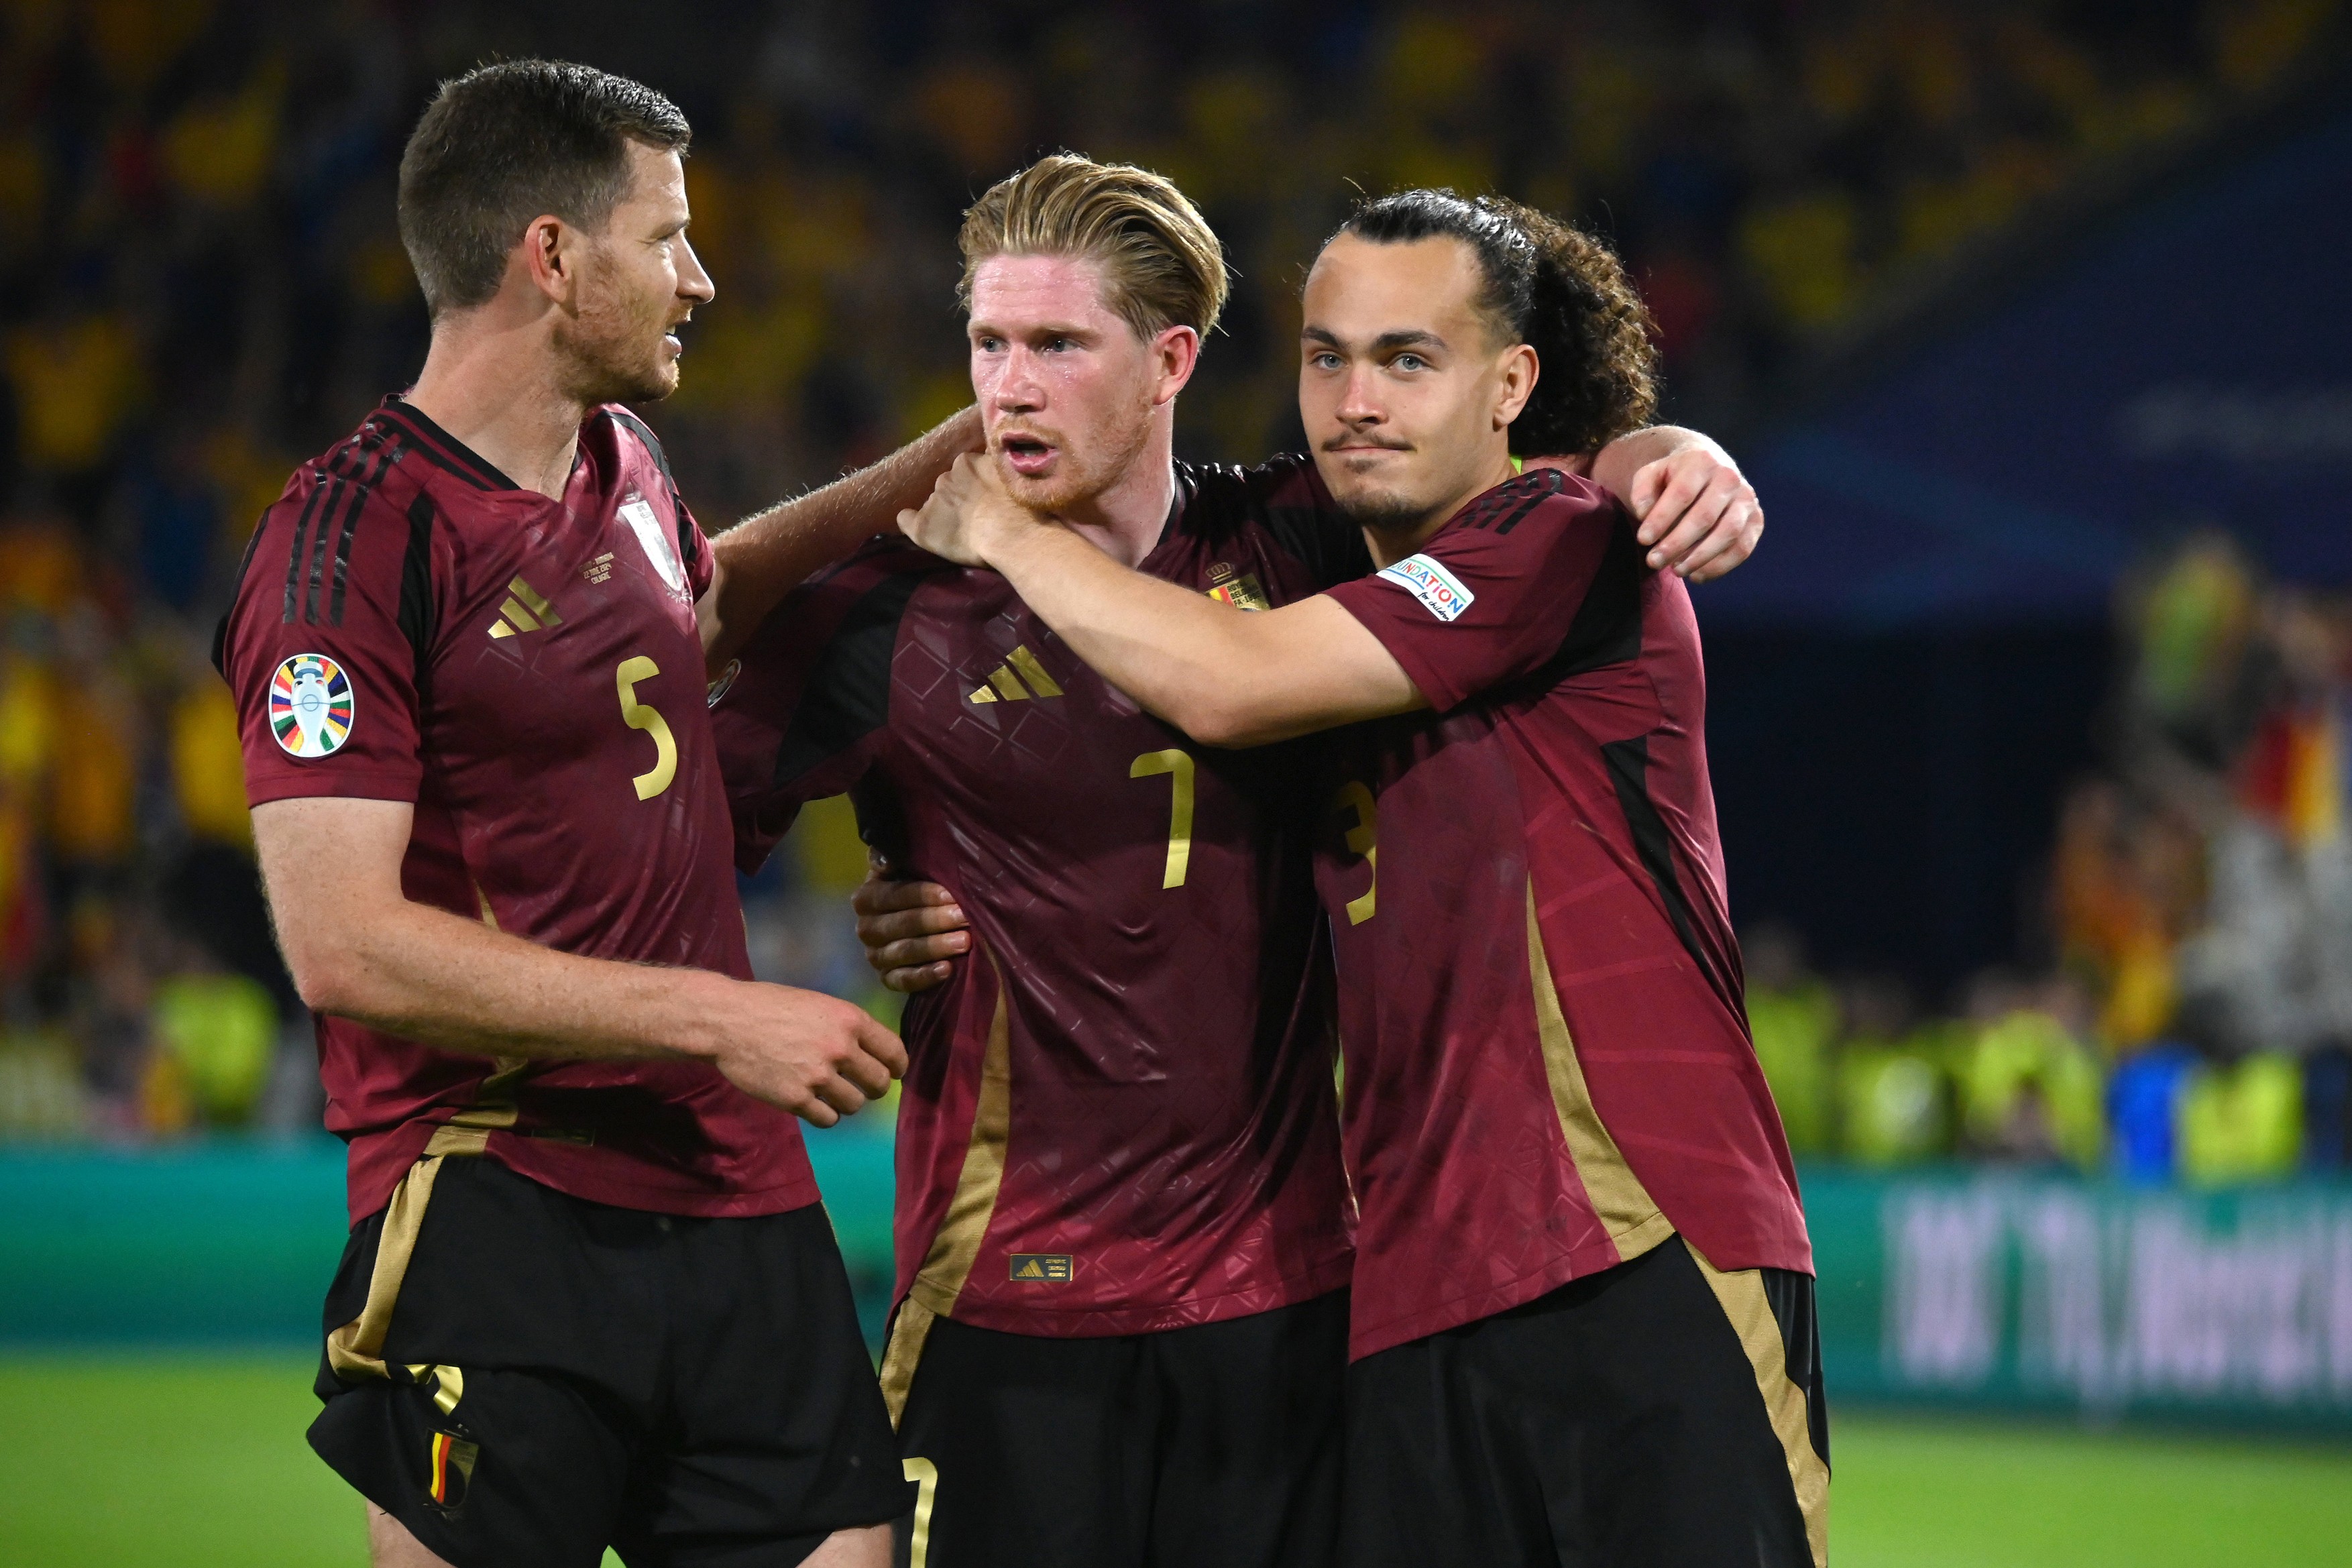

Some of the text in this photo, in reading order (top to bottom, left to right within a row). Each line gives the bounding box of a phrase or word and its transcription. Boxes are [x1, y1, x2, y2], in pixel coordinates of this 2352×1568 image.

[1417, 592, 1449, 621] for children
[616, 655, 677, 801] 5
[1129, 748, 1194, 889] 7
[901, 1457, 938, 1568] 7
